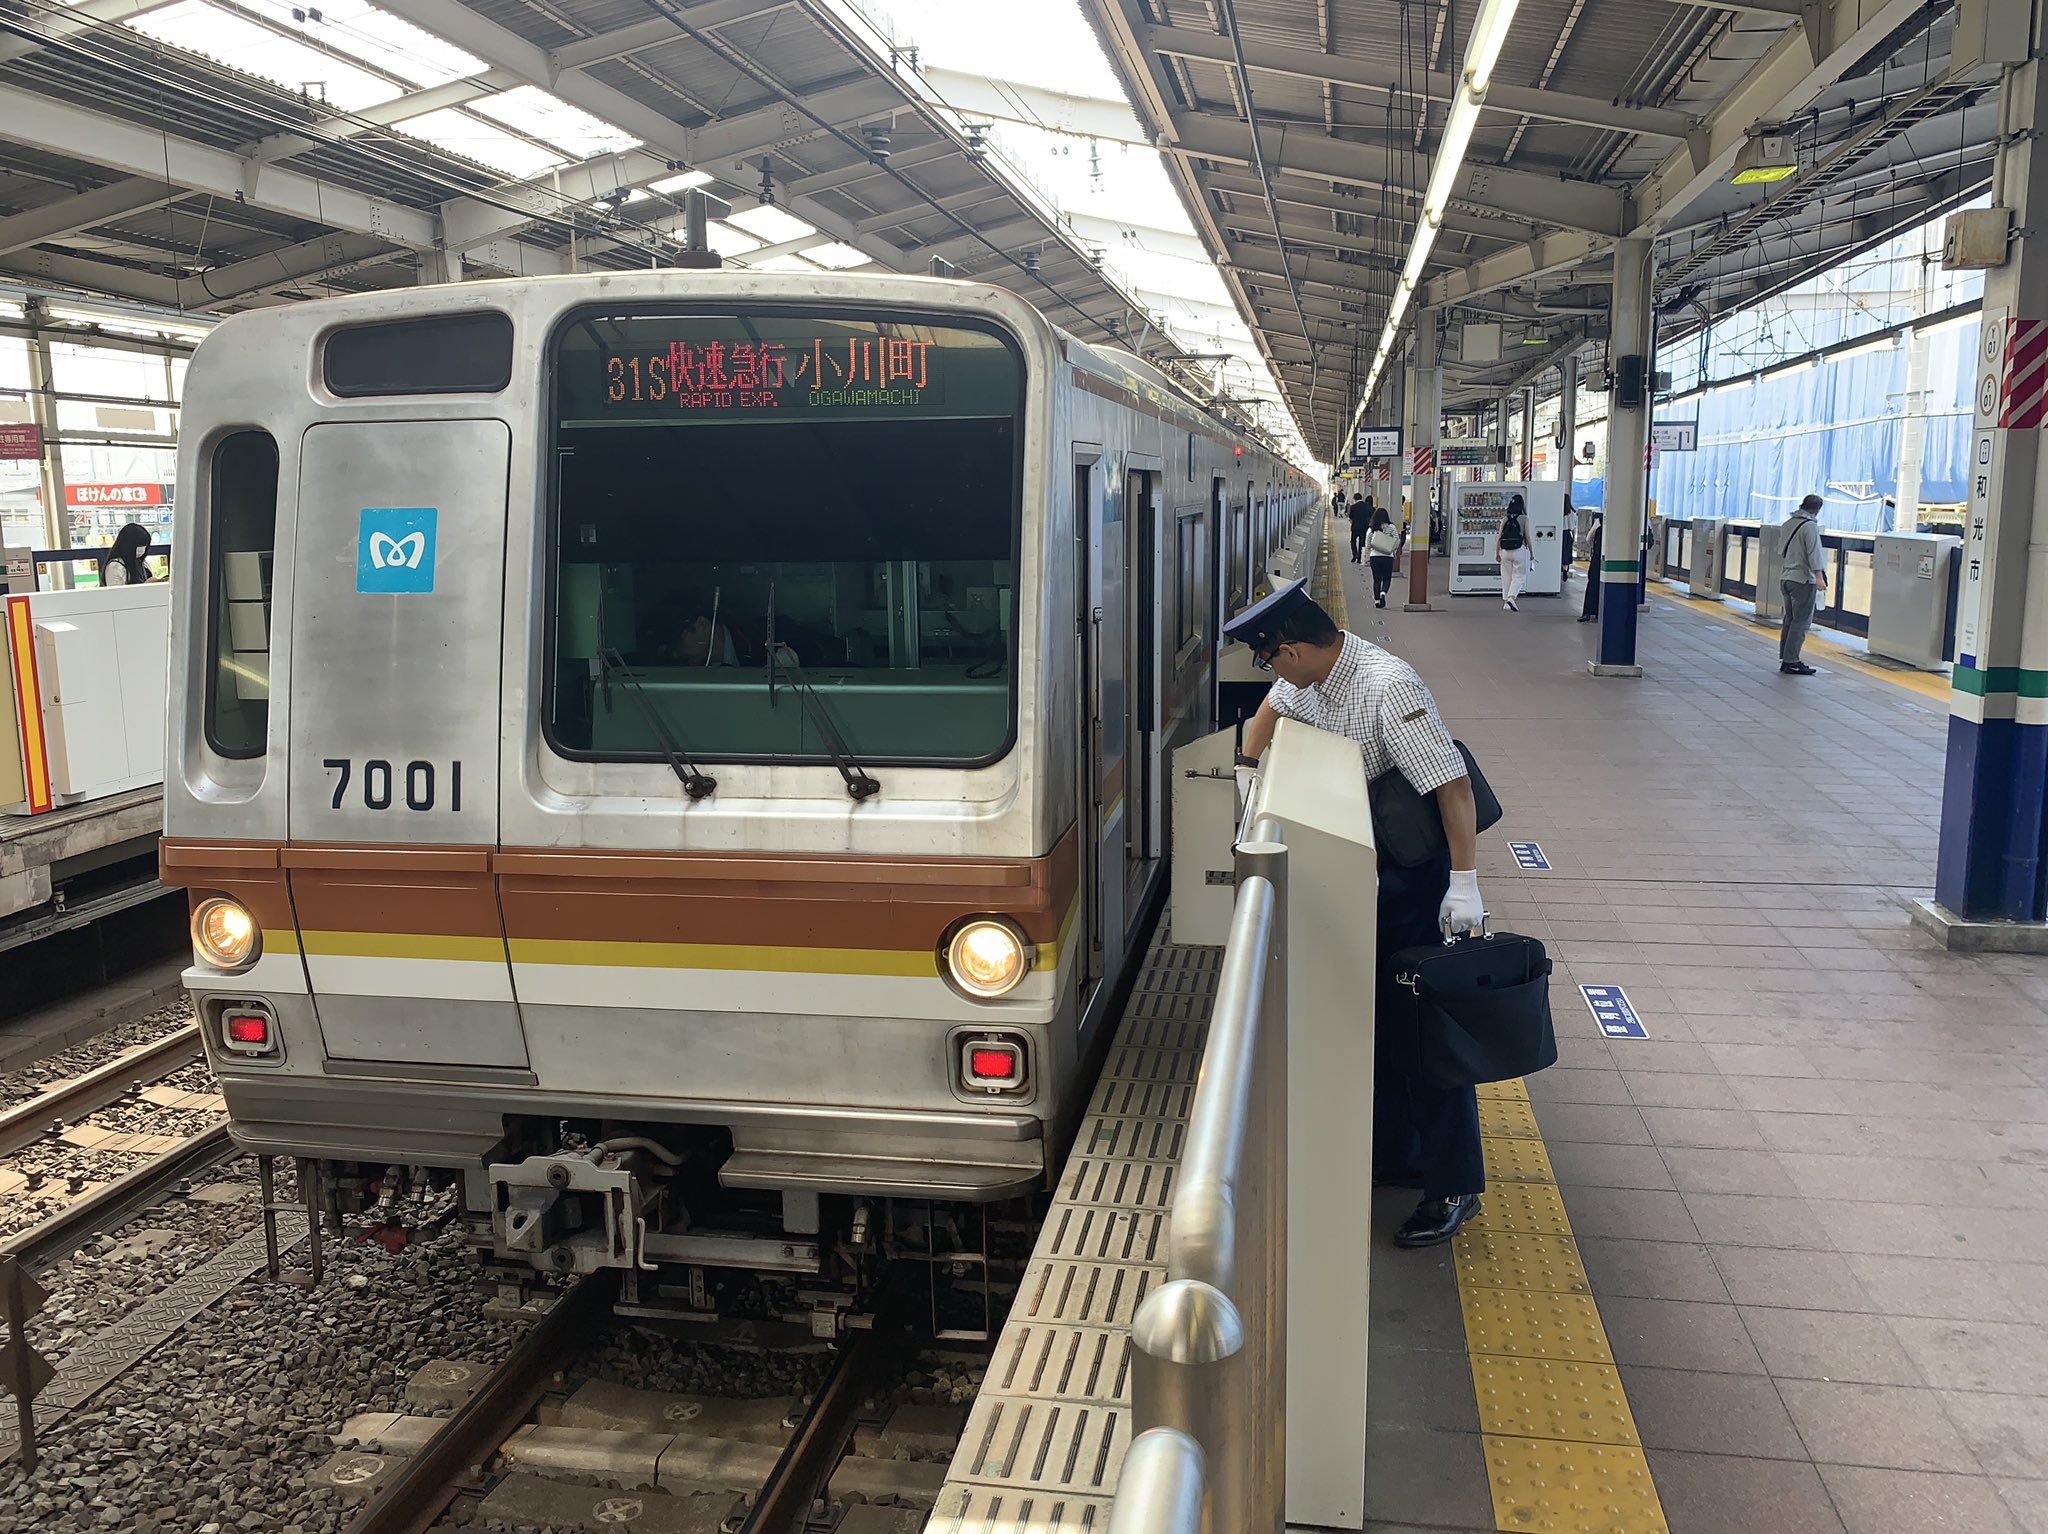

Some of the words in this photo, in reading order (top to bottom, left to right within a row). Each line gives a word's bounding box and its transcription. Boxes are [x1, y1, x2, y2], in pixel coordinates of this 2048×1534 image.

[1991, 327, 1997, 338] Y
[1987, 341, 1996, 355] 01
[608, 356, 666, 401] 31S
[665, 340, 788, 393] 快速急行
[795, 336, 936, 390] 小川町
[679, 391, 732, 408] RAPID
[740, 391, 779, 408] EXP.
[808, 388, 921, 406] OGAWAMACHI
[1983, 394, 1992, 407] 01
[1358, 437, 1367, 450] 2
[1685, 431, 1690, 444] 1
[77, 487, 146, 502] ほけんの窓口
[1969, 474, 1987, 582] 和光市
[323, 759, 461, 812] 7001
